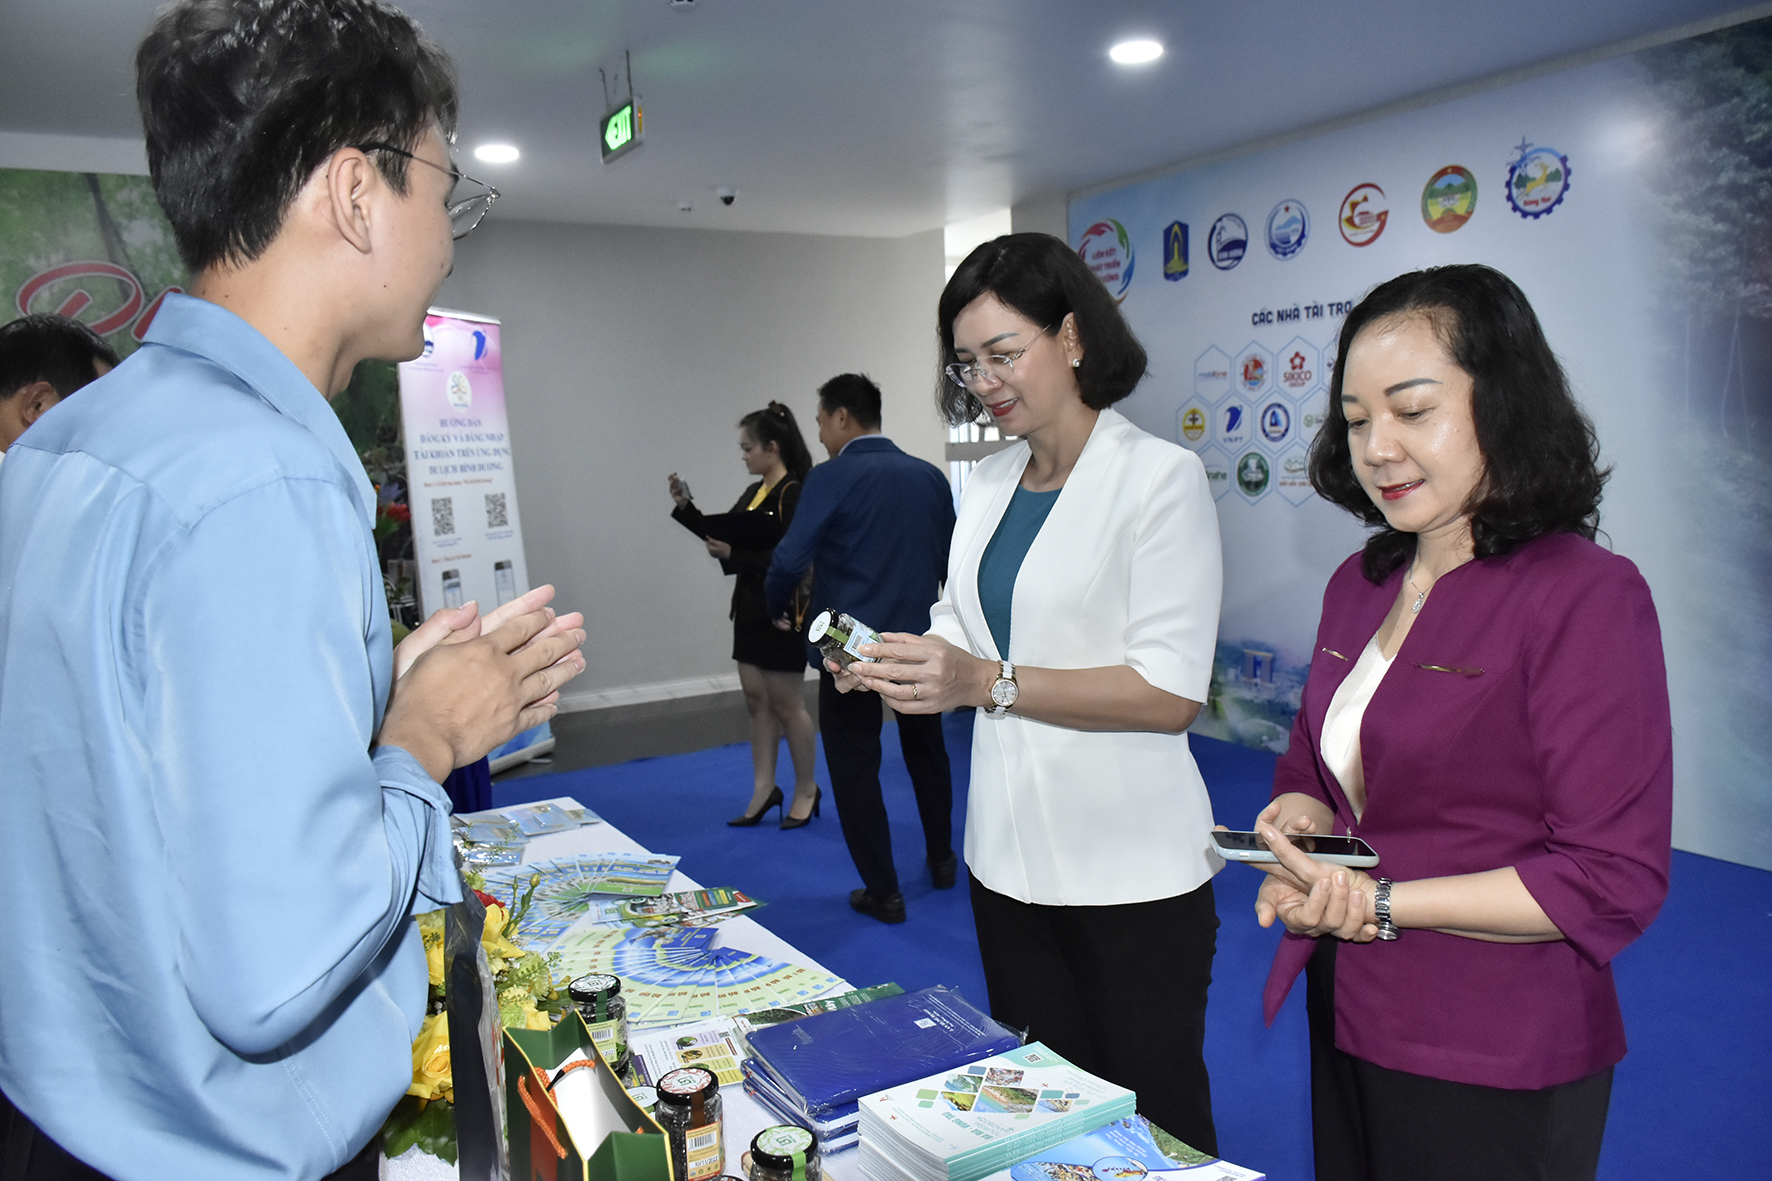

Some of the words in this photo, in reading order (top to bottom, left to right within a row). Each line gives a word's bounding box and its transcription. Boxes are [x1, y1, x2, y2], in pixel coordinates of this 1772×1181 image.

[1252, 306, 1272, 326] CÁC
[1277, 302, 1300, 322] NHÀ
[1304, 299, 1324, 319] TÀI
